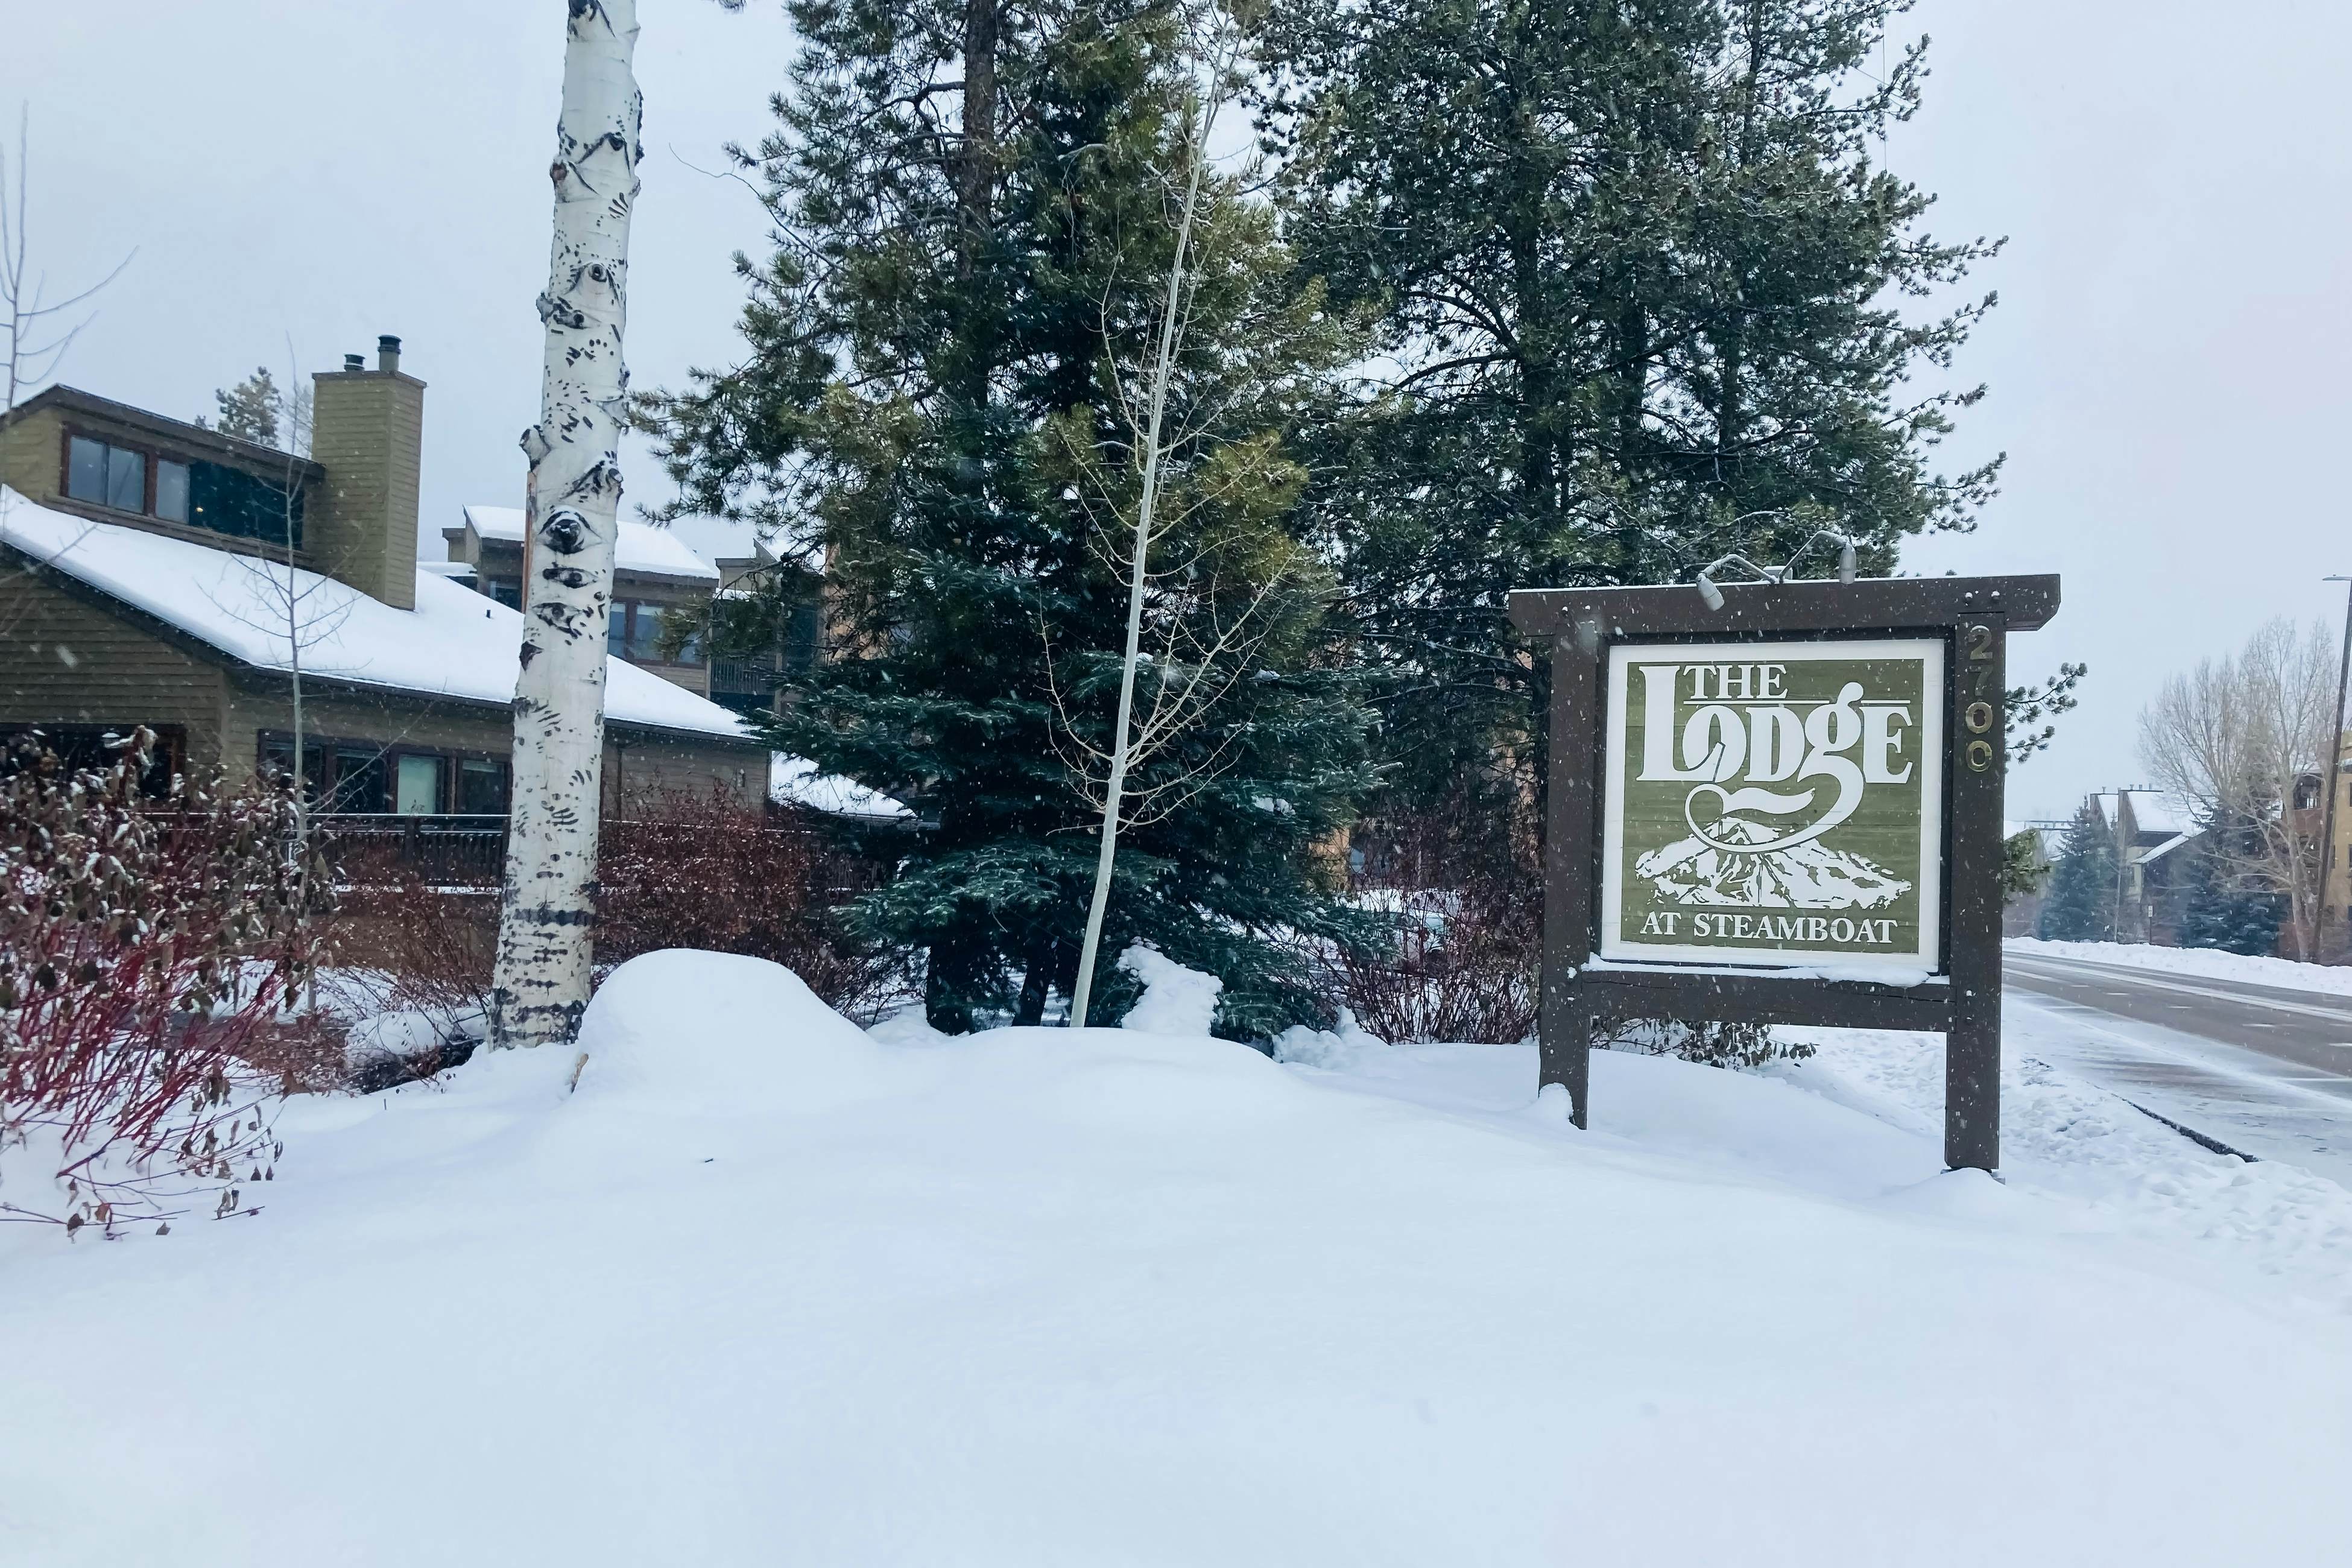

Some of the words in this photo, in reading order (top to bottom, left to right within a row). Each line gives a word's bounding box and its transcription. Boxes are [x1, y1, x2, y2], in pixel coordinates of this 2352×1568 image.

[1683, 664, 1788, 700] THE
[1965, 625, 1993, 772] 2700
[1639, 911, 1682, 936] AT
[1693, 912, 1898, 944] STEAMBOAT
